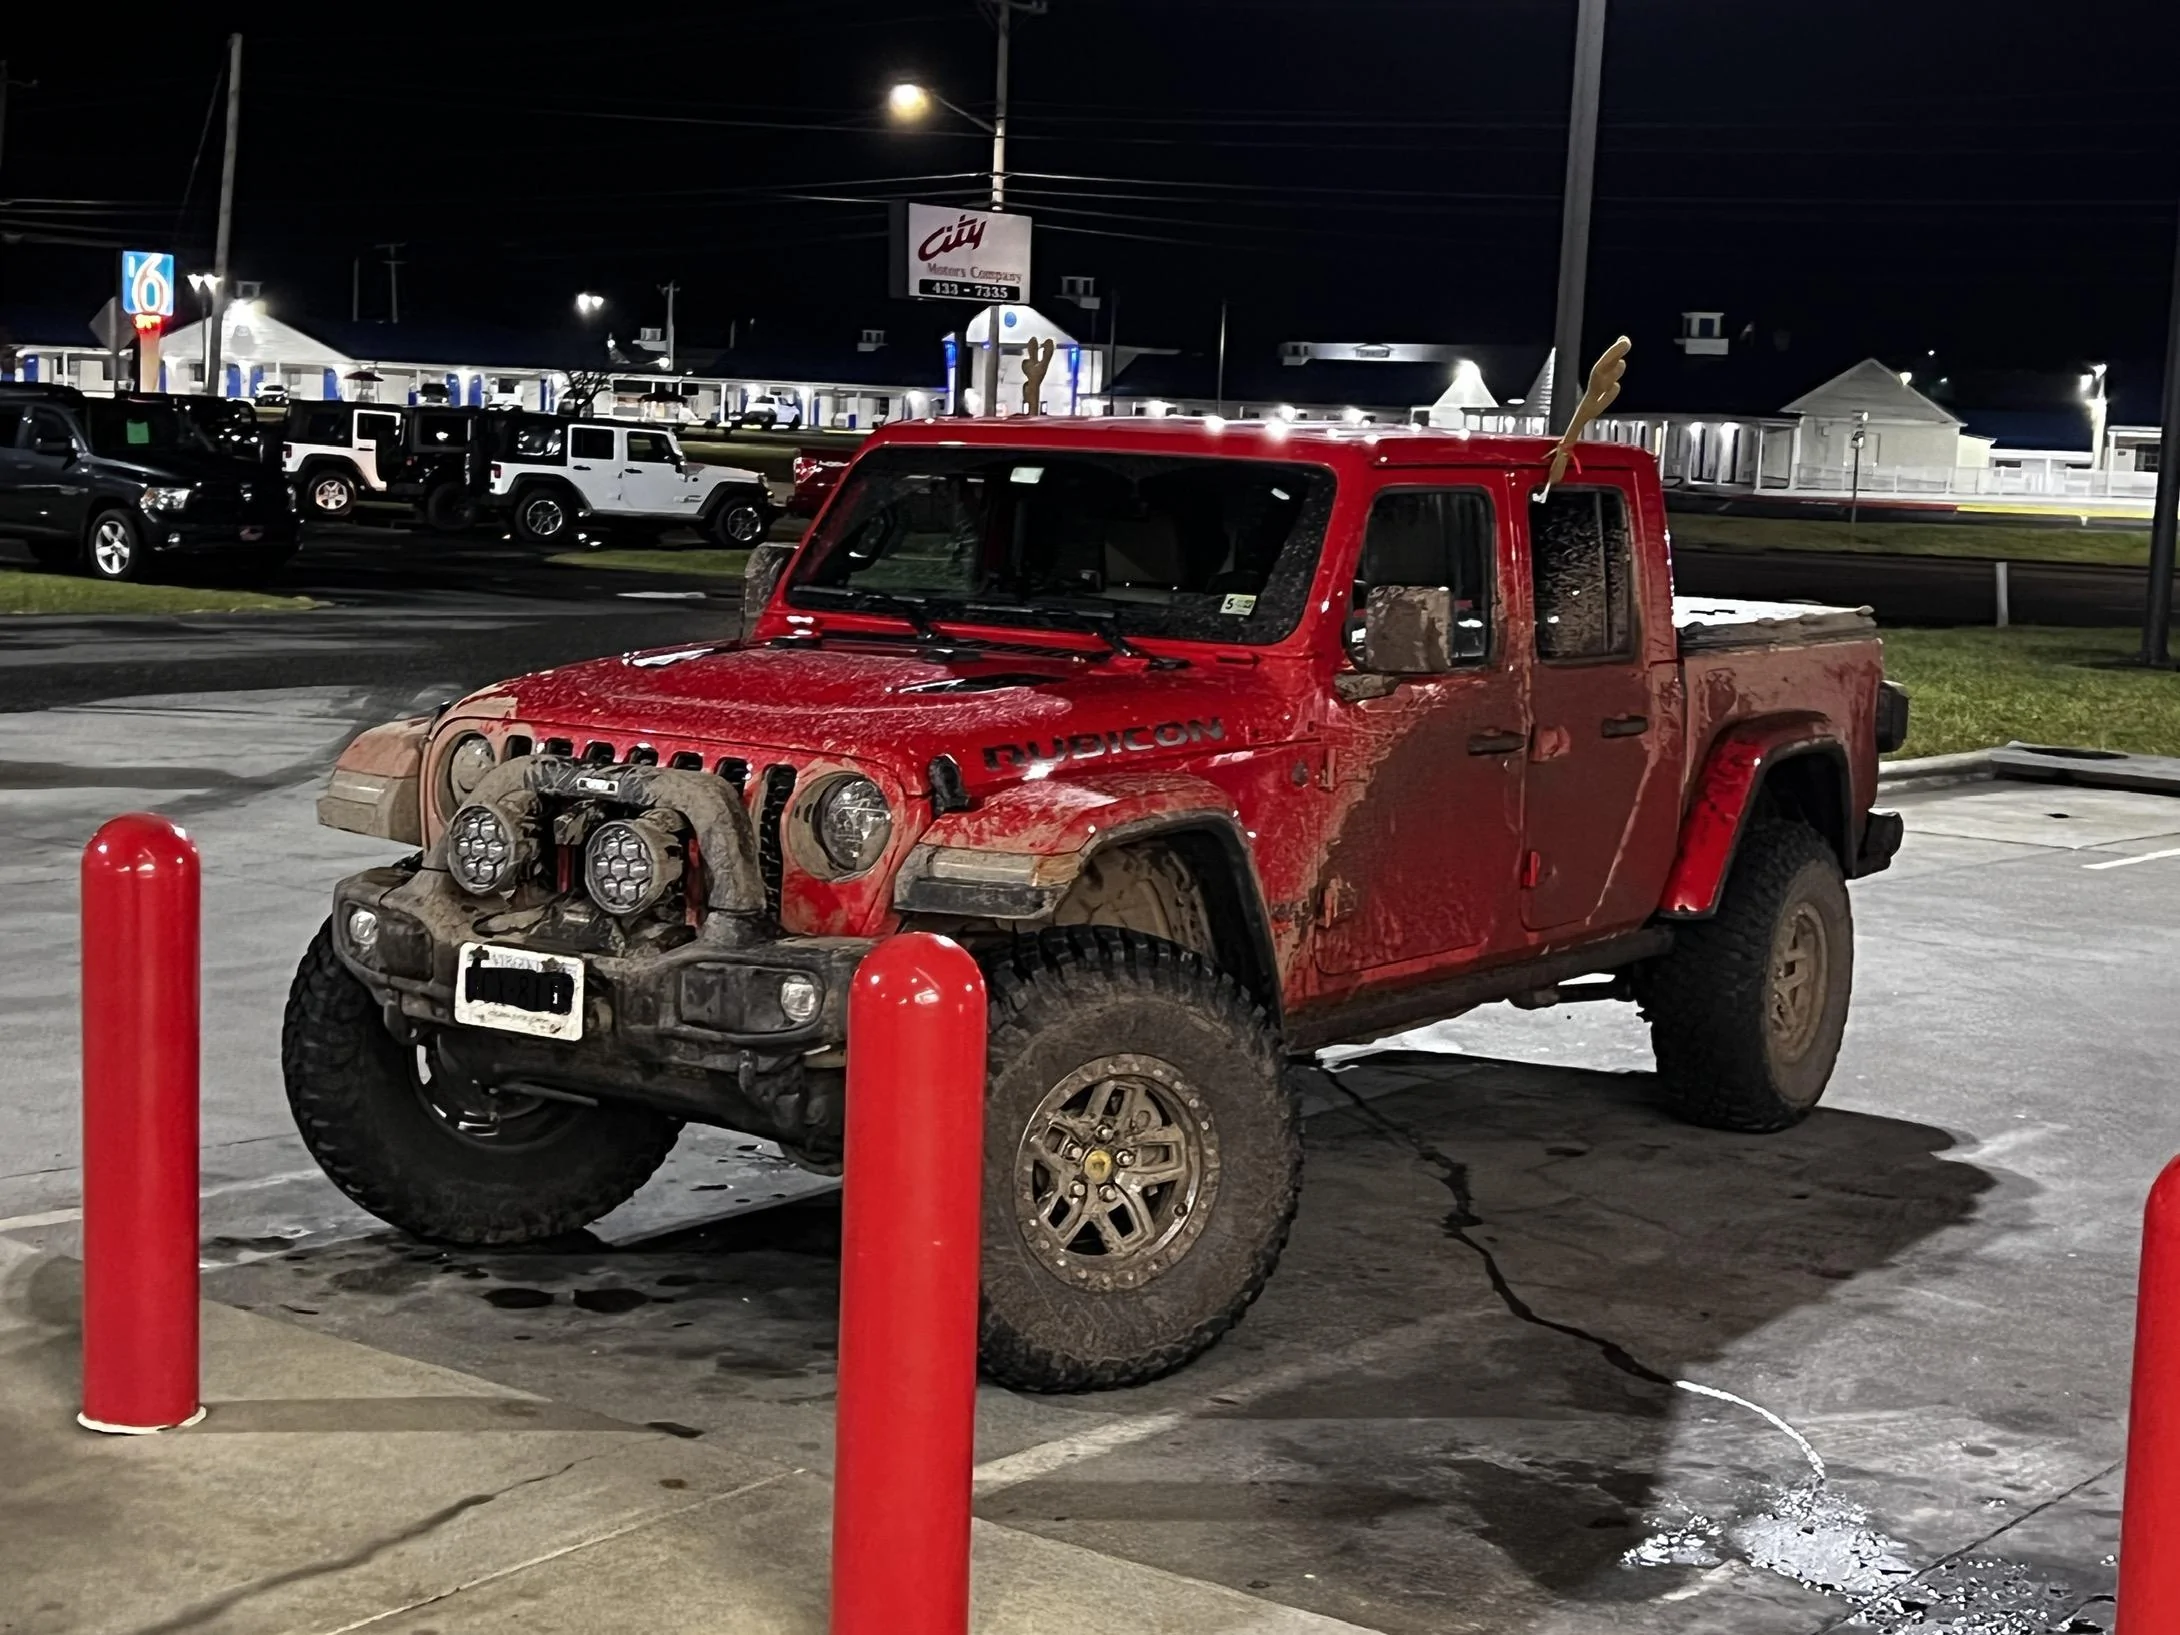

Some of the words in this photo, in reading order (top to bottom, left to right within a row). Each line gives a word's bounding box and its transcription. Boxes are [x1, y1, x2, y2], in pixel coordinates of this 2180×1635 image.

[918, 214, 988, 262] City
[131, 252, 169, 314] 6
[927, 263, 966, 278] Motors
[970, 266, 1021, 283] Company
[932, 282, 958, 295] 433
[974, 285, 1008, 298] 7335
[983, 716, 1225, 771] RUBICON
